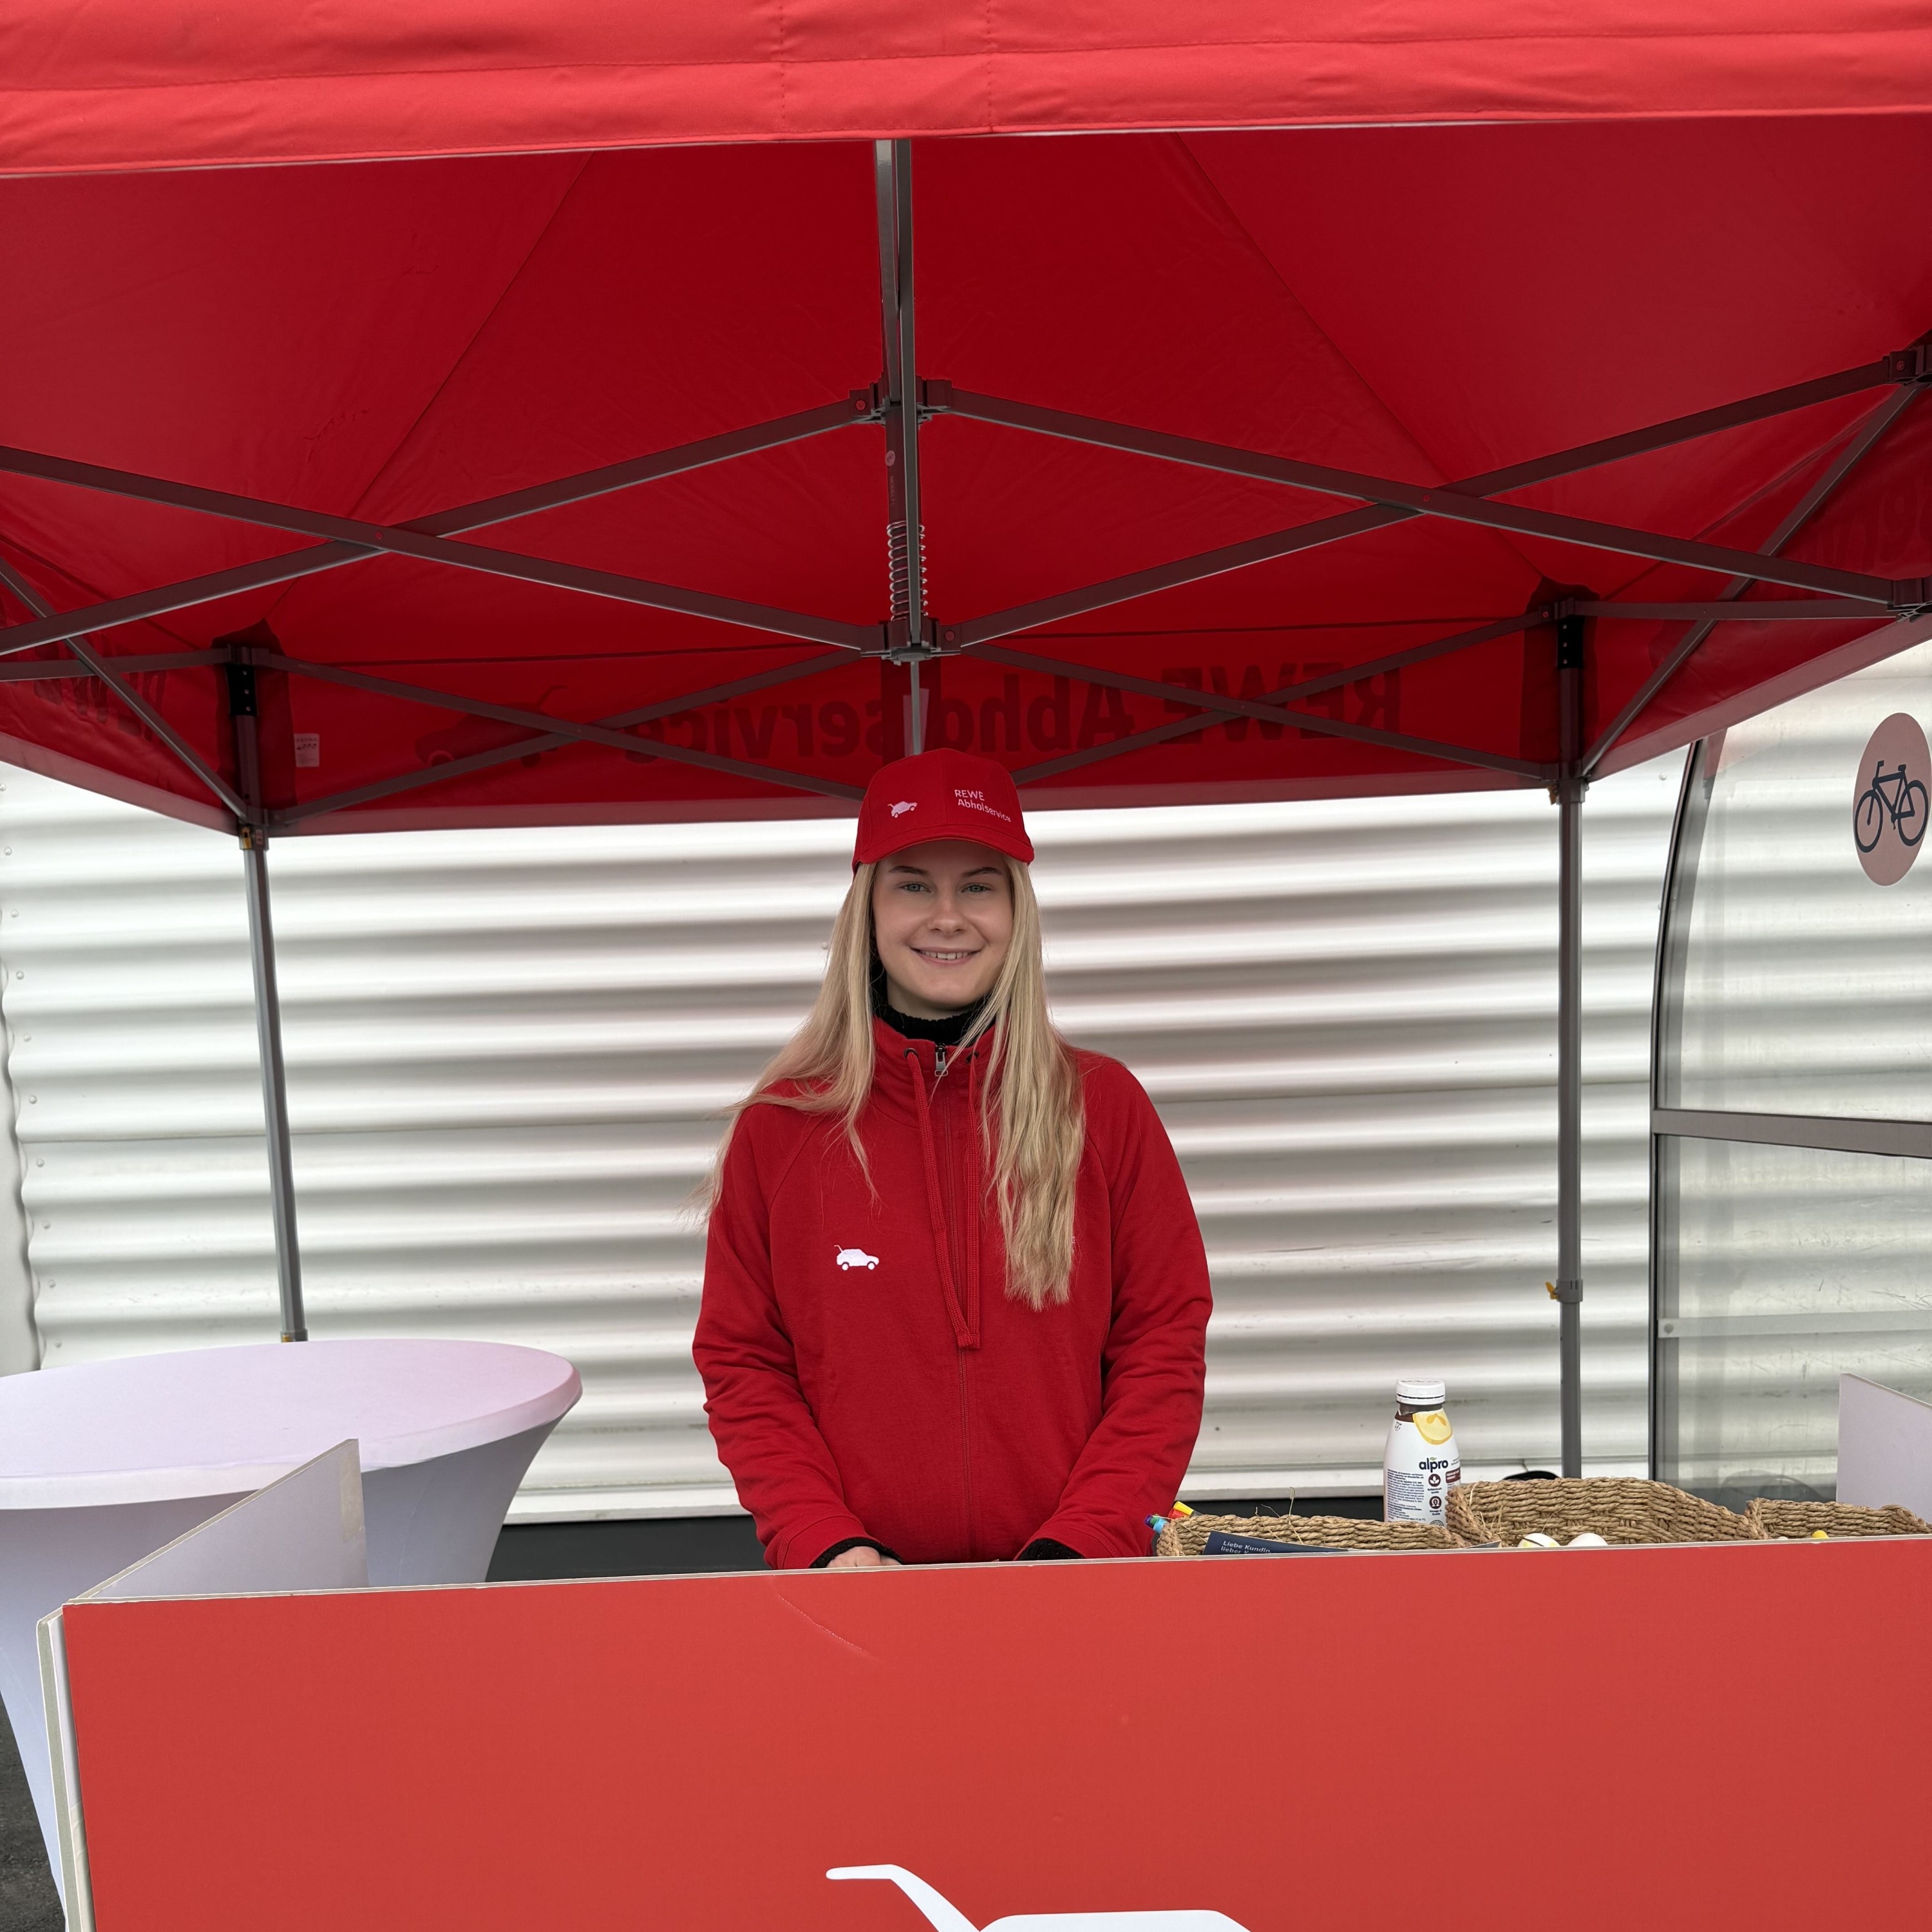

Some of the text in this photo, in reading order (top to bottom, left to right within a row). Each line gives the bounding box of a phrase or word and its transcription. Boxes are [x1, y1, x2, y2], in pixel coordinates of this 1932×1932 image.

[954, 790, 985, 800] REWE
[958, 799, 1011, 822] Abholservice
[1419, 1457, 1448, 1472] alpro
